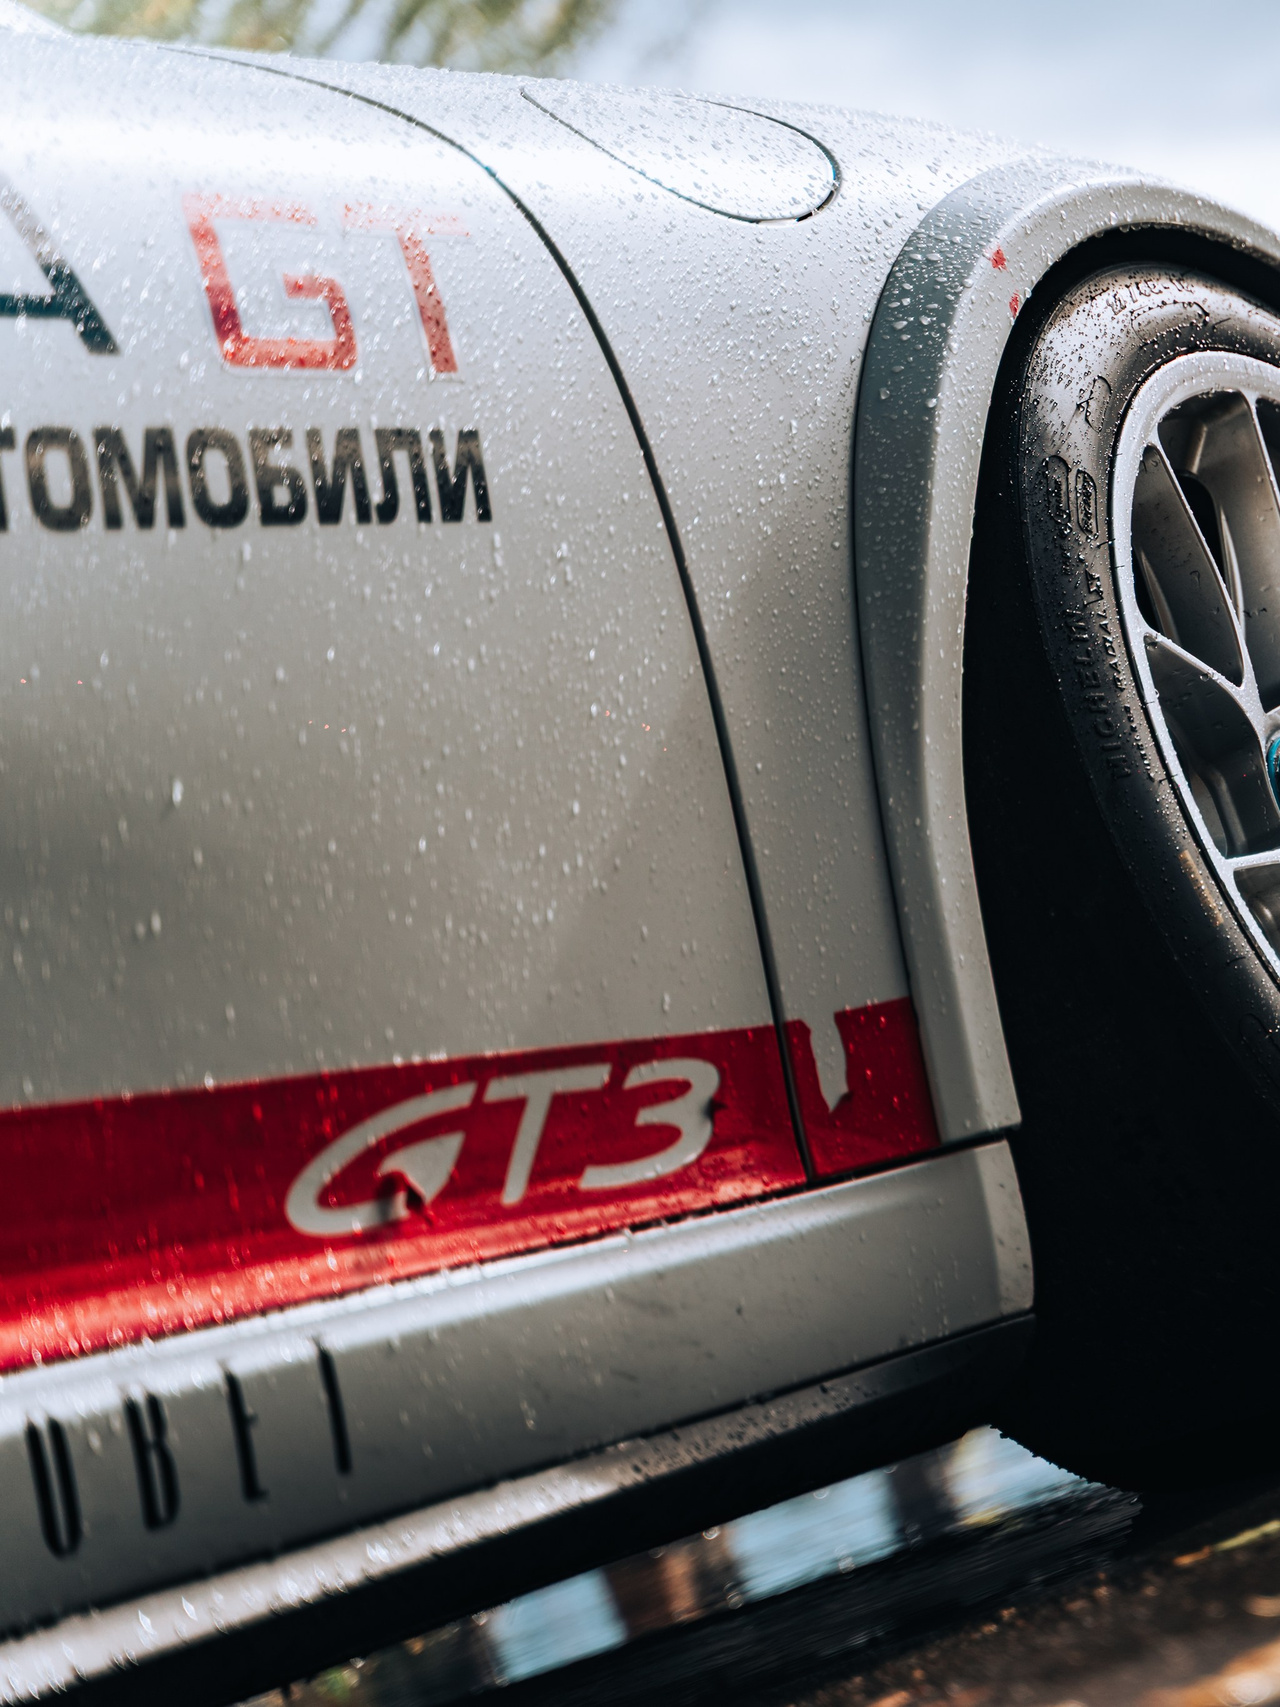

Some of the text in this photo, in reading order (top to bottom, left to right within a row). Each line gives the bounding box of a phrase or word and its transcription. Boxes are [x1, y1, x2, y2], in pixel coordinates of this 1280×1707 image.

[182, 193, 471, 374] GT
[1064, 608, 1132, 779] MICHELIN
[284, 1057, 721, 1238] GT3
